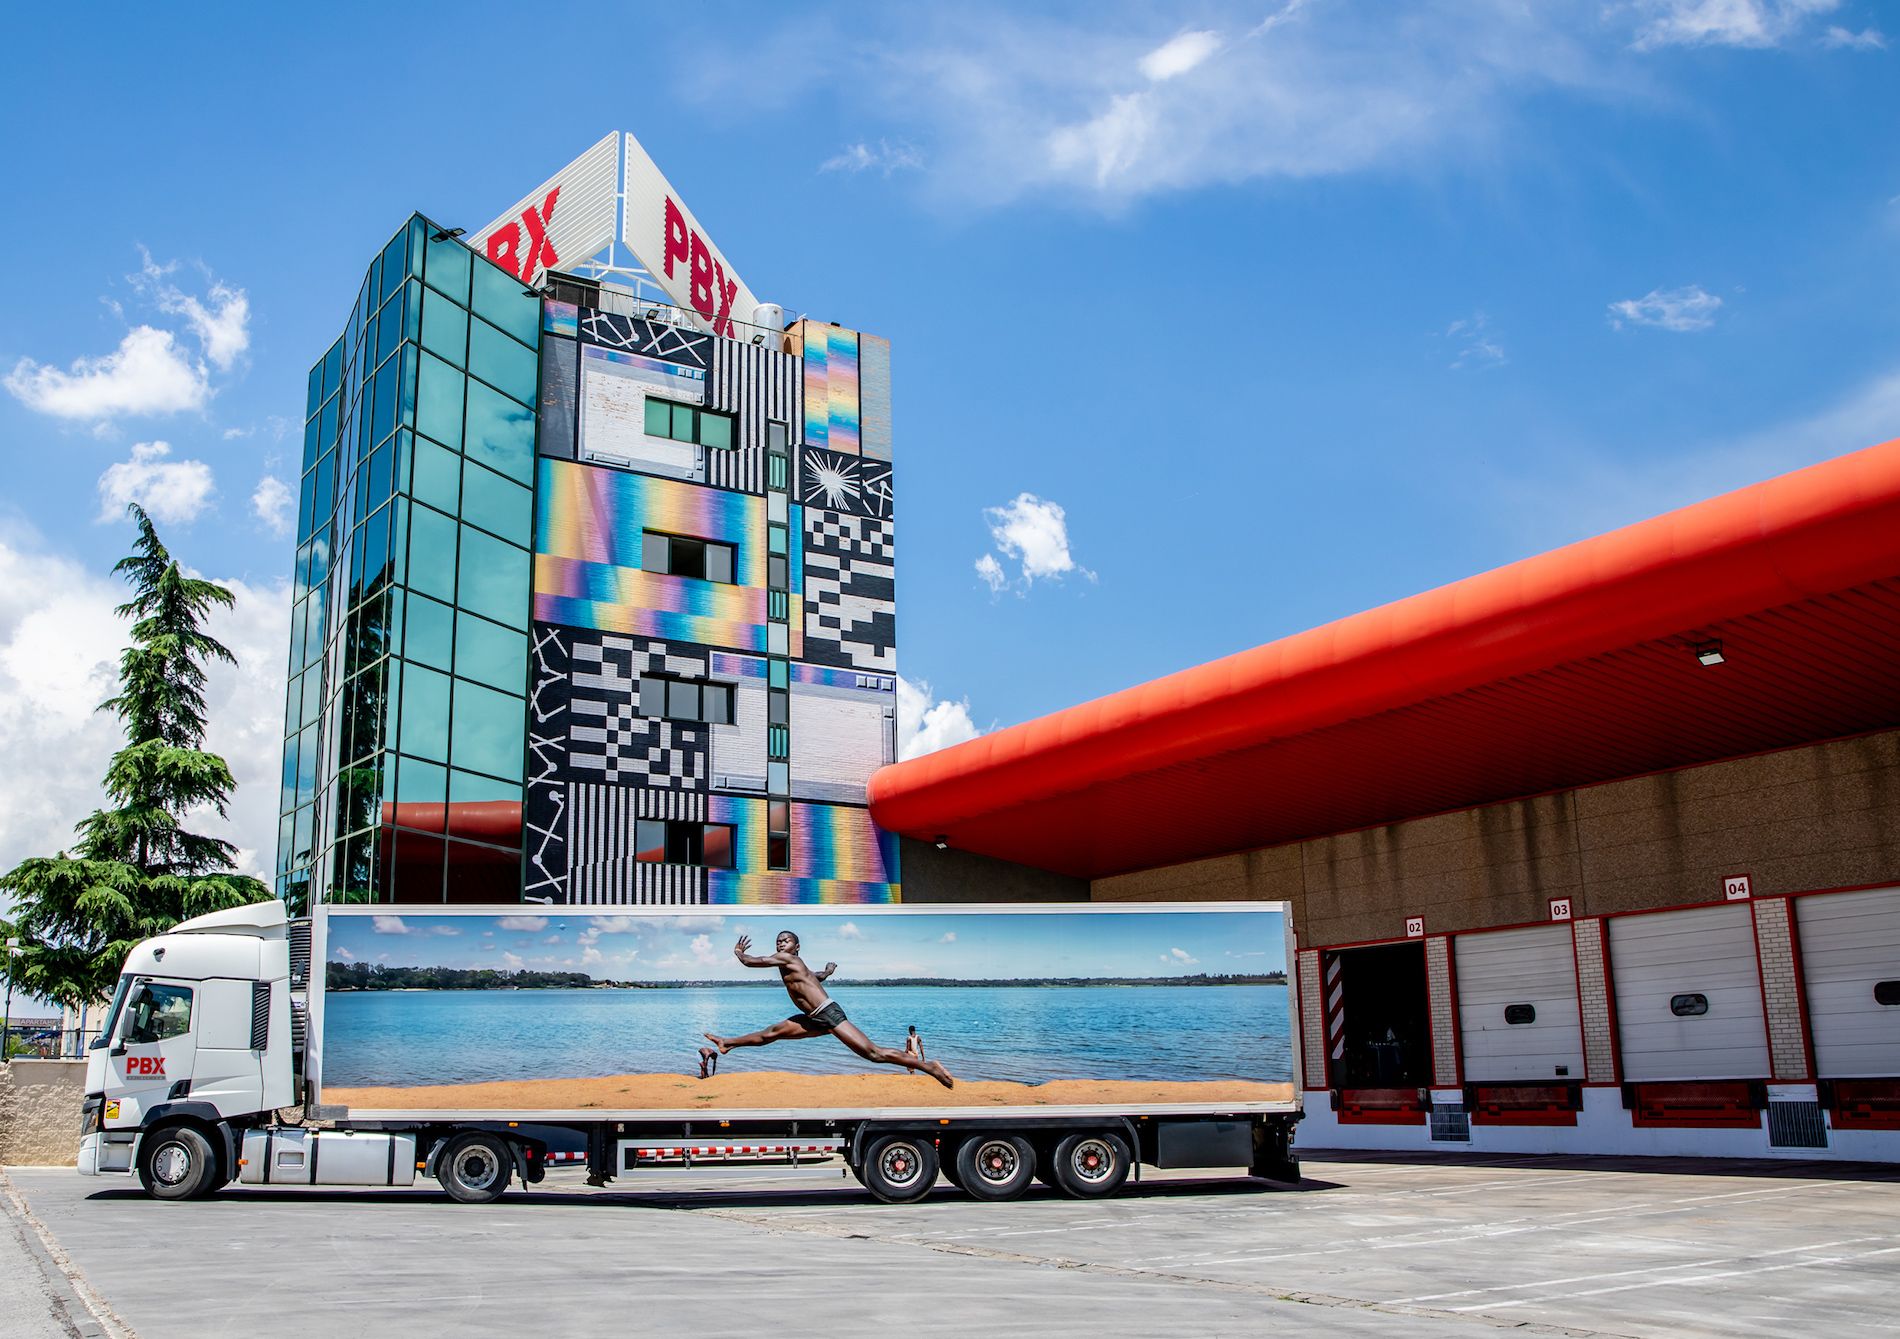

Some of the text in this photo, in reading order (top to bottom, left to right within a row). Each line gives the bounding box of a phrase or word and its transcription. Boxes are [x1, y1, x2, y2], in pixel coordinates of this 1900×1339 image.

[477, 186, 561, 284] BX
[664, 195, 738, 340] PBX
[1728, 882, 1746, 895] 04
[1553, 904, 1568, 916] 03
[1409, 922, 1421, 933] 02
[126, 1057, 166, 1074] PBX
